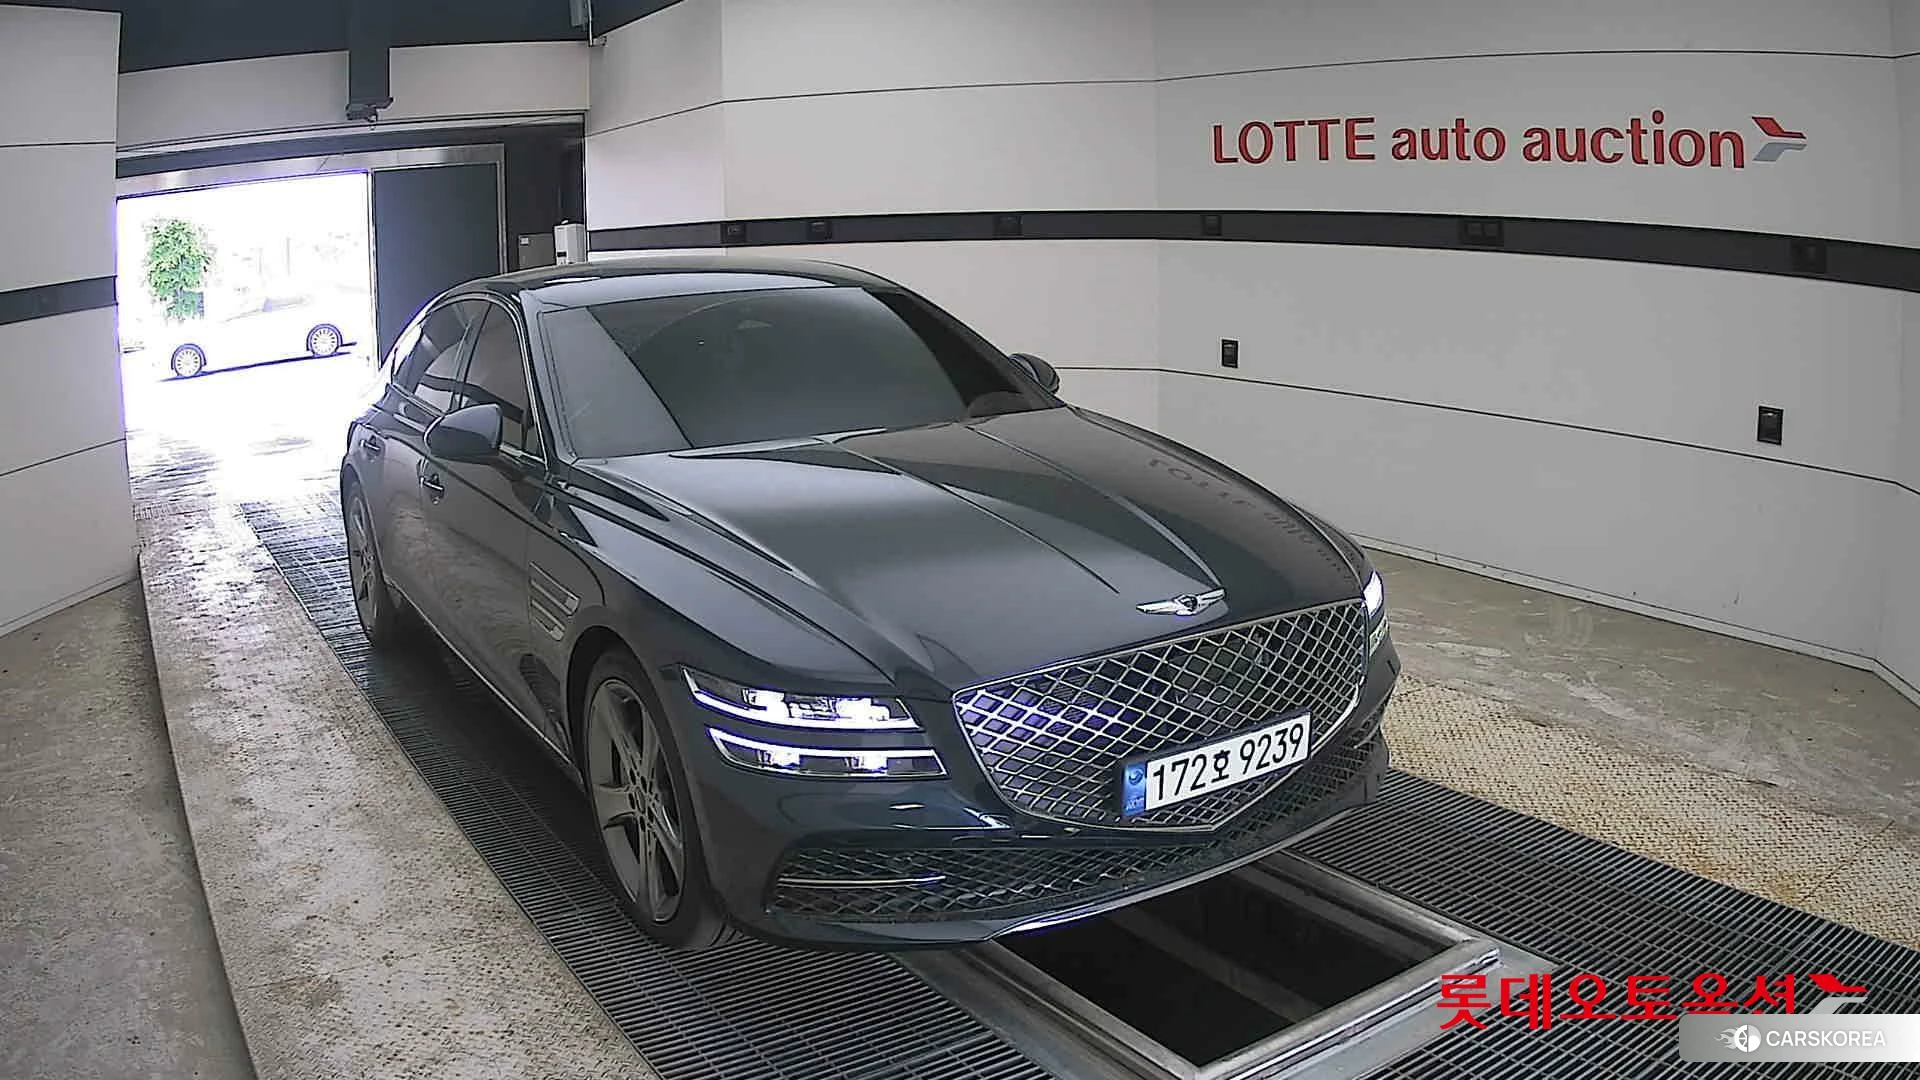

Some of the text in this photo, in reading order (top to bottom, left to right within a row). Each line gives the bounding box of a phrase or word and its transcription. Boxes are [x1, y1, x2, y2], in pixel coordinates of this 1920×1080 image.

[1212, 110, 1745, 169] LOTTE auto auction
[1152, 723, 1305, 801] 172호 9239
